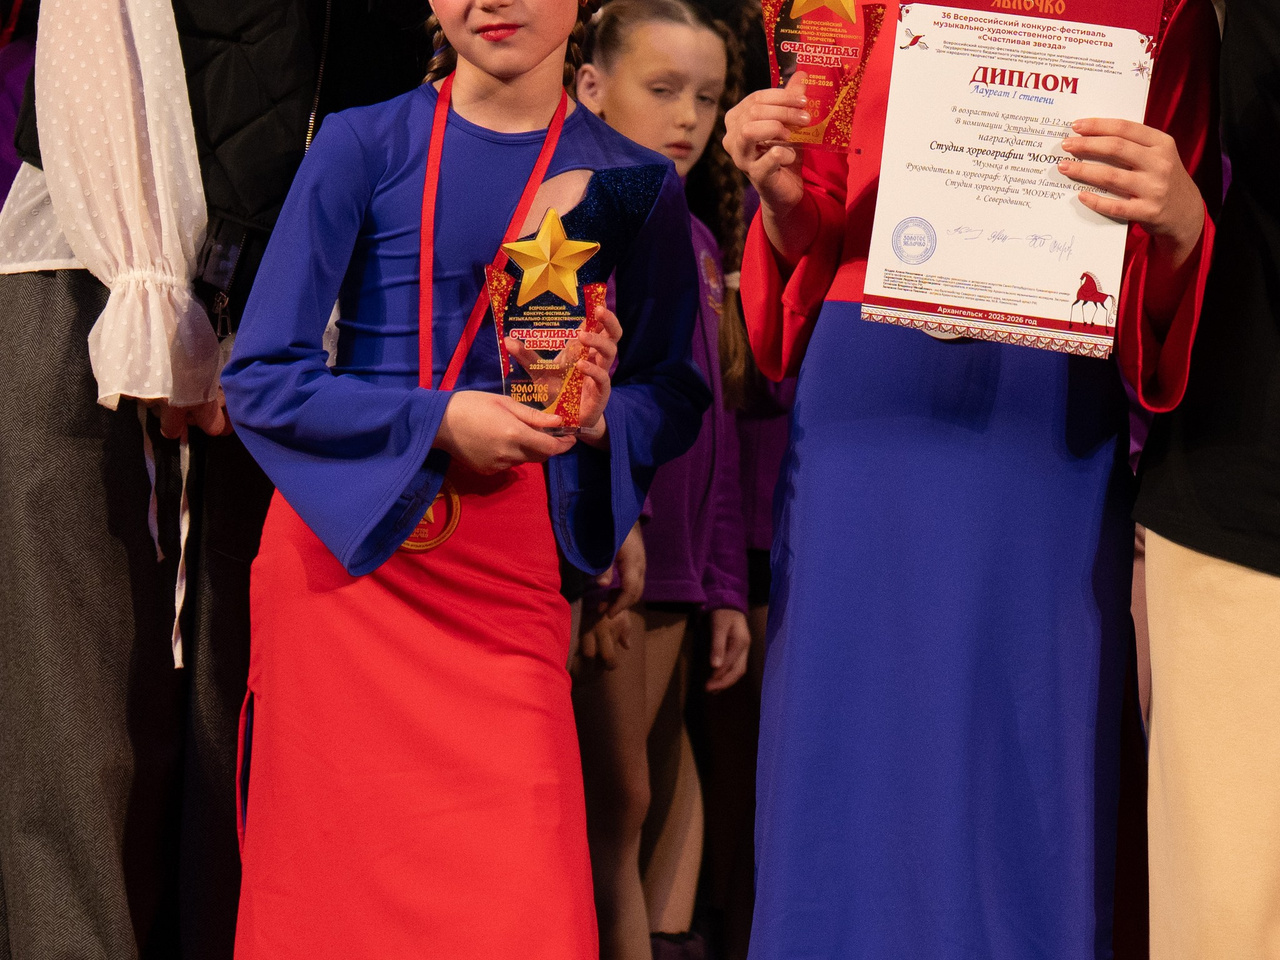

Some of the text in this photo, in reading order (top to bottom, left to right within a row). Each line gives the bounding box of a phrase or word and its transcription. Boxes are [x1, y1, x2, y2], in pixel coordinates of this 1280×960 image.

[941, 11, 1106, 37] 36 Всероссийский конкурс-фестиваль
[933, 20, 1112, 47] музыкально-художественного творчества
[977, 33, 1066, 49] «Счастливая звезда»
[781, 41, 859, 57] СЧАСТЛИВАЯ
[797, 54, 841, 67] ЗВЕЗДА
[968, 65, 1079, 94] ДИПЛОМ
[970, 84, 1009, 97] Лауреат
[1018, 93, 1054, 104] степени
[957, 108, 999, 117] возрастной
[1000, 113, 1038, 123] категории
[1041, 116, 1060, 125] 10-12
[962, 119, 1002, 129] номинации
[978, 134, 1042, 147] награждается
[929, 140, 964, 153] Студия
[965, 147, 1023, 161] хореографии
[944, 178, 972, 189] Студия
[973, 183, 1019, 195] хореографии
[983, 194, 1031, 208] Северодвинск
[937, 305, 983, 317] Архангельск
[988, 312, 1023, 323] 2025-2026
[525, 339, 566, 350] ЗВЕЗДА
